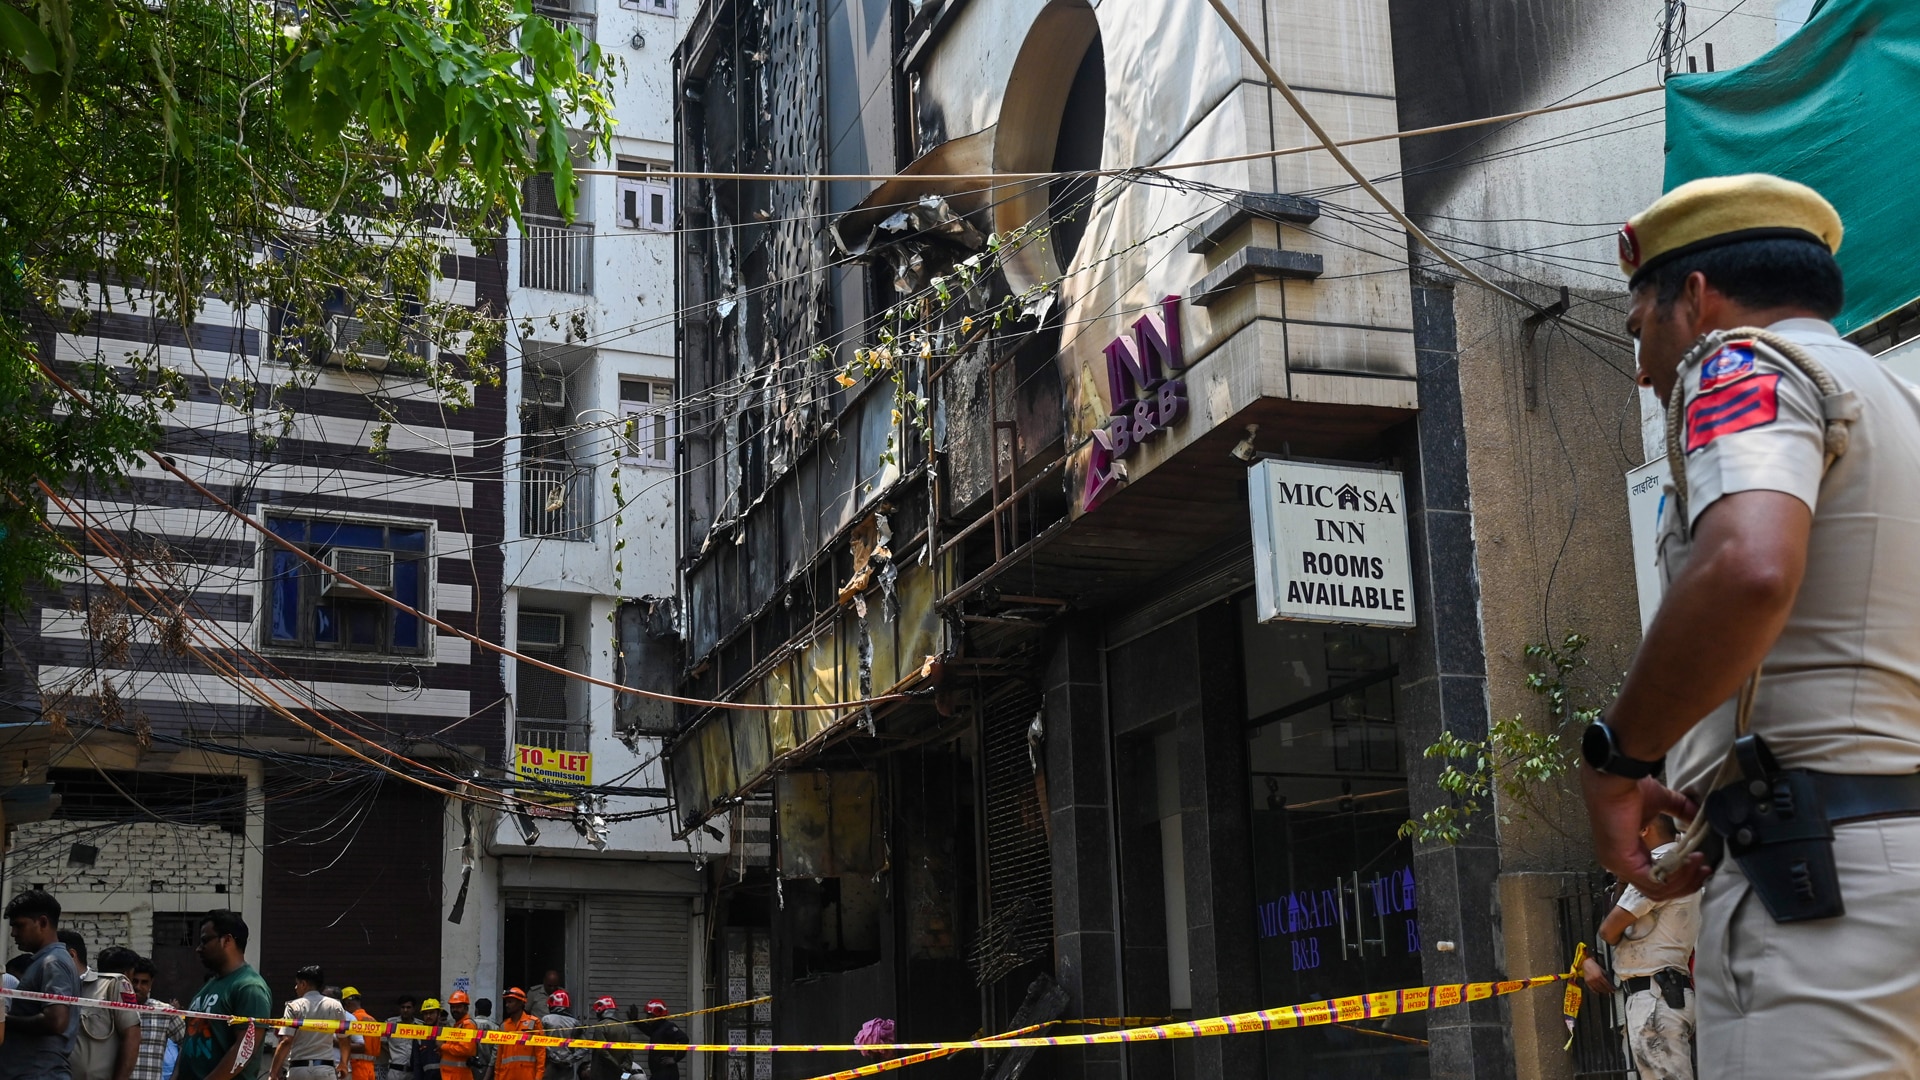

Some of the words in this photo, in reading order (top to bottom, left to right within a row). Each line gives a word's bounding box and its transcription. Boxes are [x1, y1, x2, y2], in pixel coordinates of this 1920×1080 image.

[1110, 379, 1189, 460] B&B
[1631, 475, 1659, 496] लाइटिंग
[1314, 519, 1365, 545] INN
[1302, 551, 1384, 580] ROOMS
[1287, 580, 1406, 611] AVAILABLE
[519, 747, 543, 766] TO
[559, 753, 589, 772] LET
[534, 767, 586, 782] Commission
[1290, 936, 1321, 972] B&B
[1405, 991, 1427, 999] POLICE
[1407, 1001, 1426, 1009] DELHI
[352, 1022, 362, 1030] DO
[365, 1022, 381, 1031] NOT
[1308, 1013, 1328, 1022] DELHI
[400, 1028, 426, 1036] DELHI
[489, 1032, 499, 1040] DO
